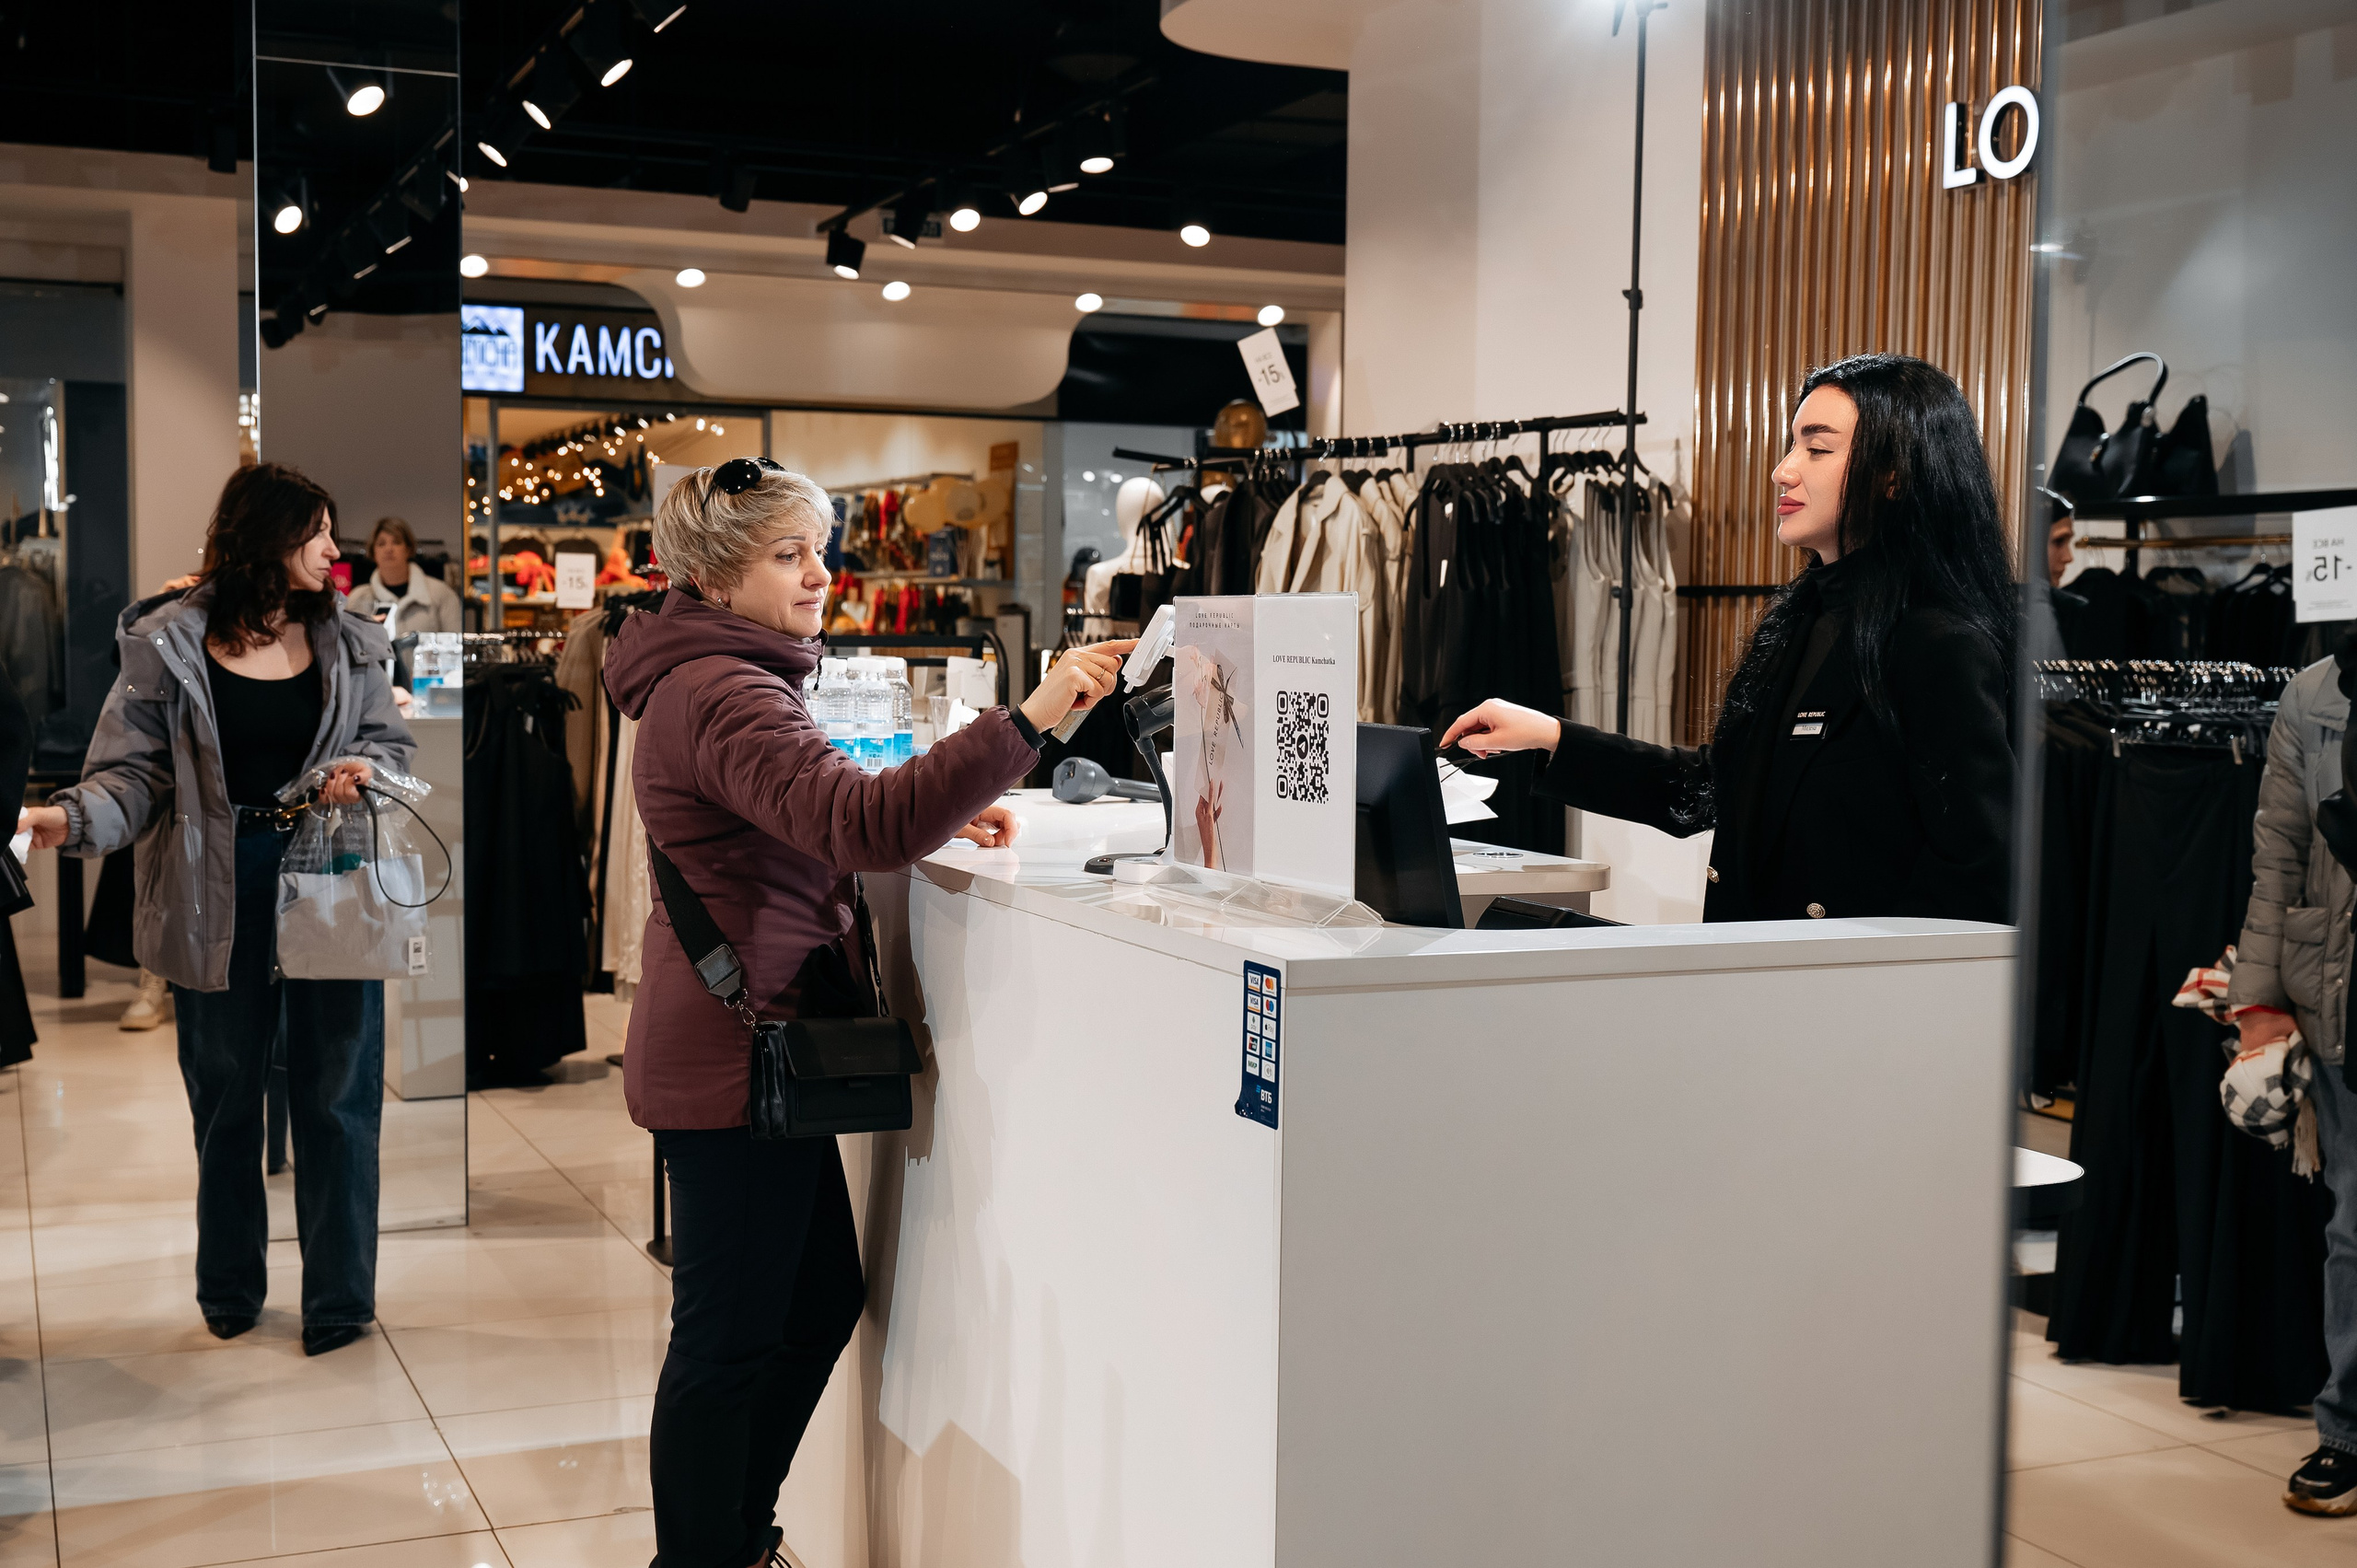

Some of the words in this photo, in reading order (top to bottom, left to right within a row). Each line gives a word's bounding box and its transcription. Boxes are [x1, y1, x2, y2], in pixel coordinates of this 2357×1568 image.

[1943, 85, 2040, 190] LO
[535, 321, 675, 379] KAMC
[1272, 655, 1285, 663] LOVE
[1286, 655, 1311, 664] REPUBLIC
[1311, 656, 1336, 665] Kamchatka
[1213, 692, 1224, 737] REPUBLIC
[1249, 976, 1259, 985] VISA
[1249, 996, 1259, 1005] VISA
[1260, 1088, 1272, 1104] ВТБ
